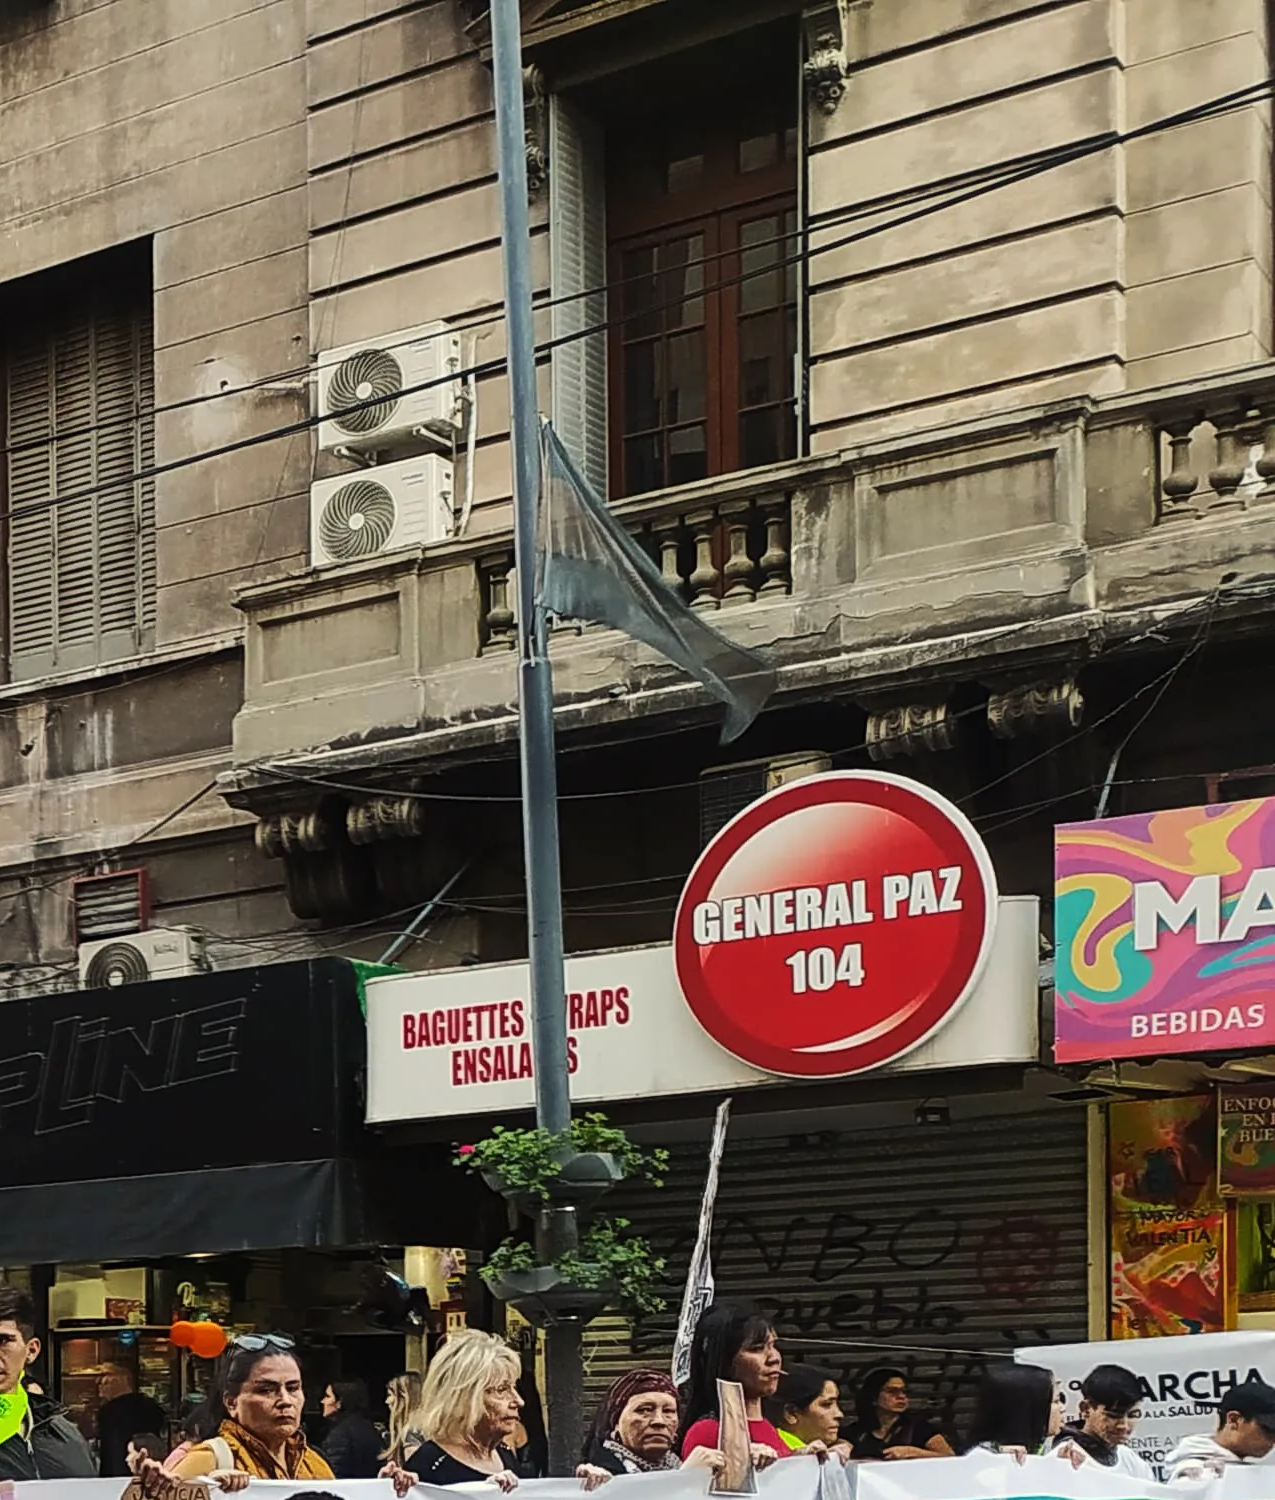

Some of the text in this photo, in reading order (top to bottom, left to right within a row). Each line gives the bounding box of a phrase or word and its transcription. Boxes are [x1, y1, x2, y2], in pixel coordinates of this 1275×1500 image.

[692, 866, 964, 947] GENERAL PAZ
[785, 943, 866, 995] 104
[402, 1000, 525, 1050] BAGUETTES
[1132, 1004, 1265, 1039] BEBIDAS
[451, 1037, 579, 1087] ENSALAS
[1224, 1097, 1275, 1112] ENFO
[1168, 1405, 1213, 1417] SALUD
